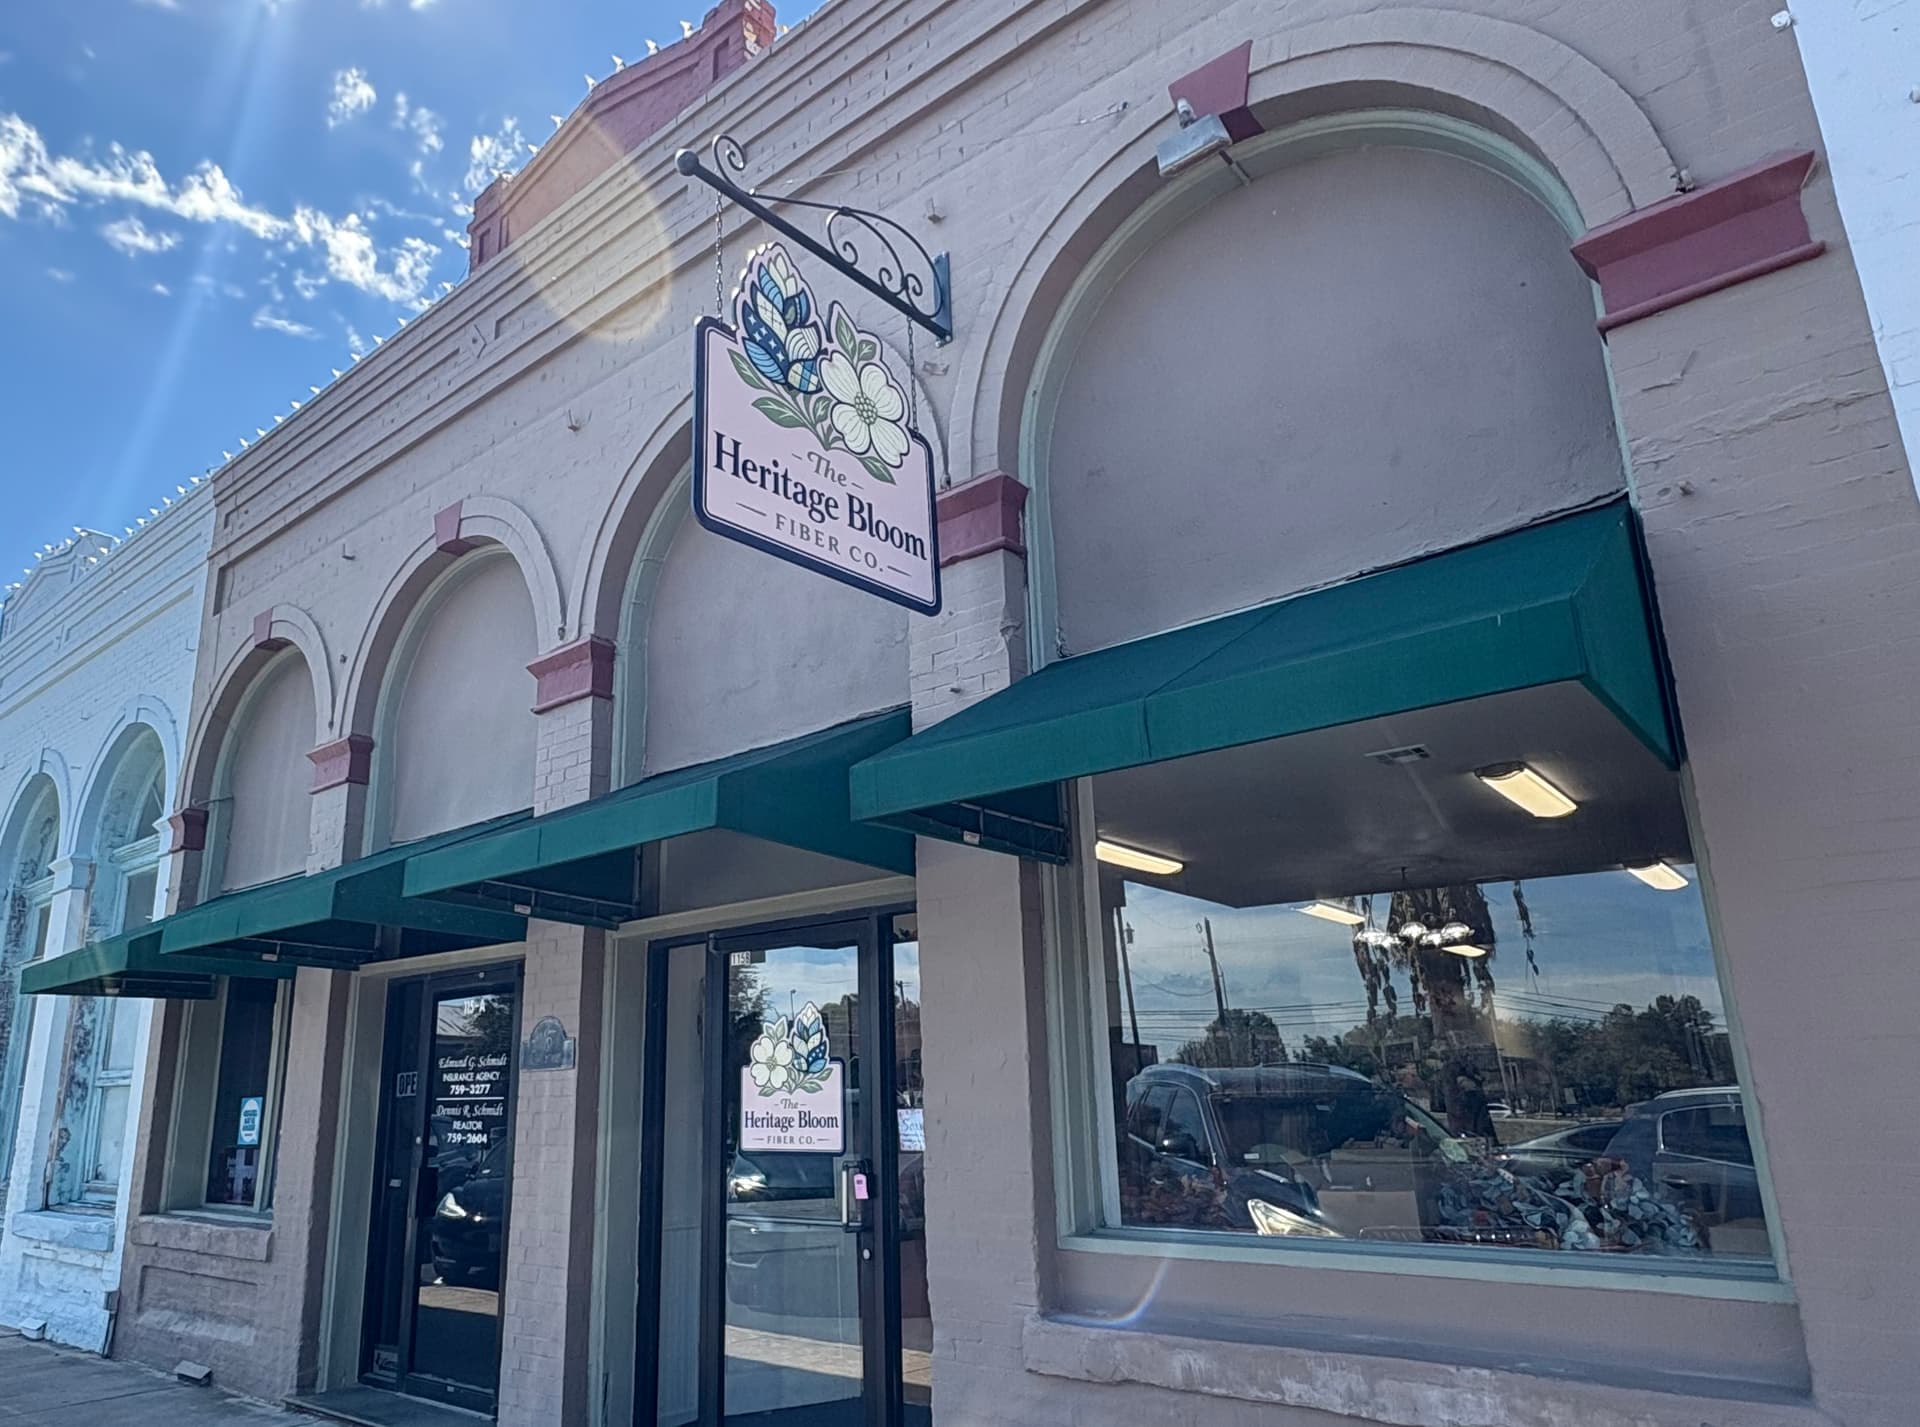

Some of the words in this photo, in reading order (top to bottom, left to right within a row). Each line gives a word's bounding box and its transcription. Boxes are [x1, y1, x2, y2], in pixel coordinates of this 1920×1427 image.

[807, 451, 847, 487] The
[713, 431, 840, 523] Heritage
[847, 493, 927, 561] Bloom
[776, 514, 840, 555] FIBER
[850, 545, 883, 573] CO.
[477, 1053, 507, 1068] Schmidt
[443, 1072, 474, 1082] INSURANCE
[475, 1071, 500, 1081] AGENCY
[450, 1084, 491, 1095] 759-3277
[436, 1104, 462, 1116] Dennis
[472, 1102, 503, 1117] Schmidt
[780, 1098, 799, 1110] The
[452, 1120, 483, 1130] REALTOR
[745, 1111, 795, 1133] Heritage
[798, 1111, 839, 1129] Bloom
[447, 1133, 488, 1144] 759-2604
[767, 1136, 795, 1145] FIBER
[798, 1136, 816, 1145] CO.
